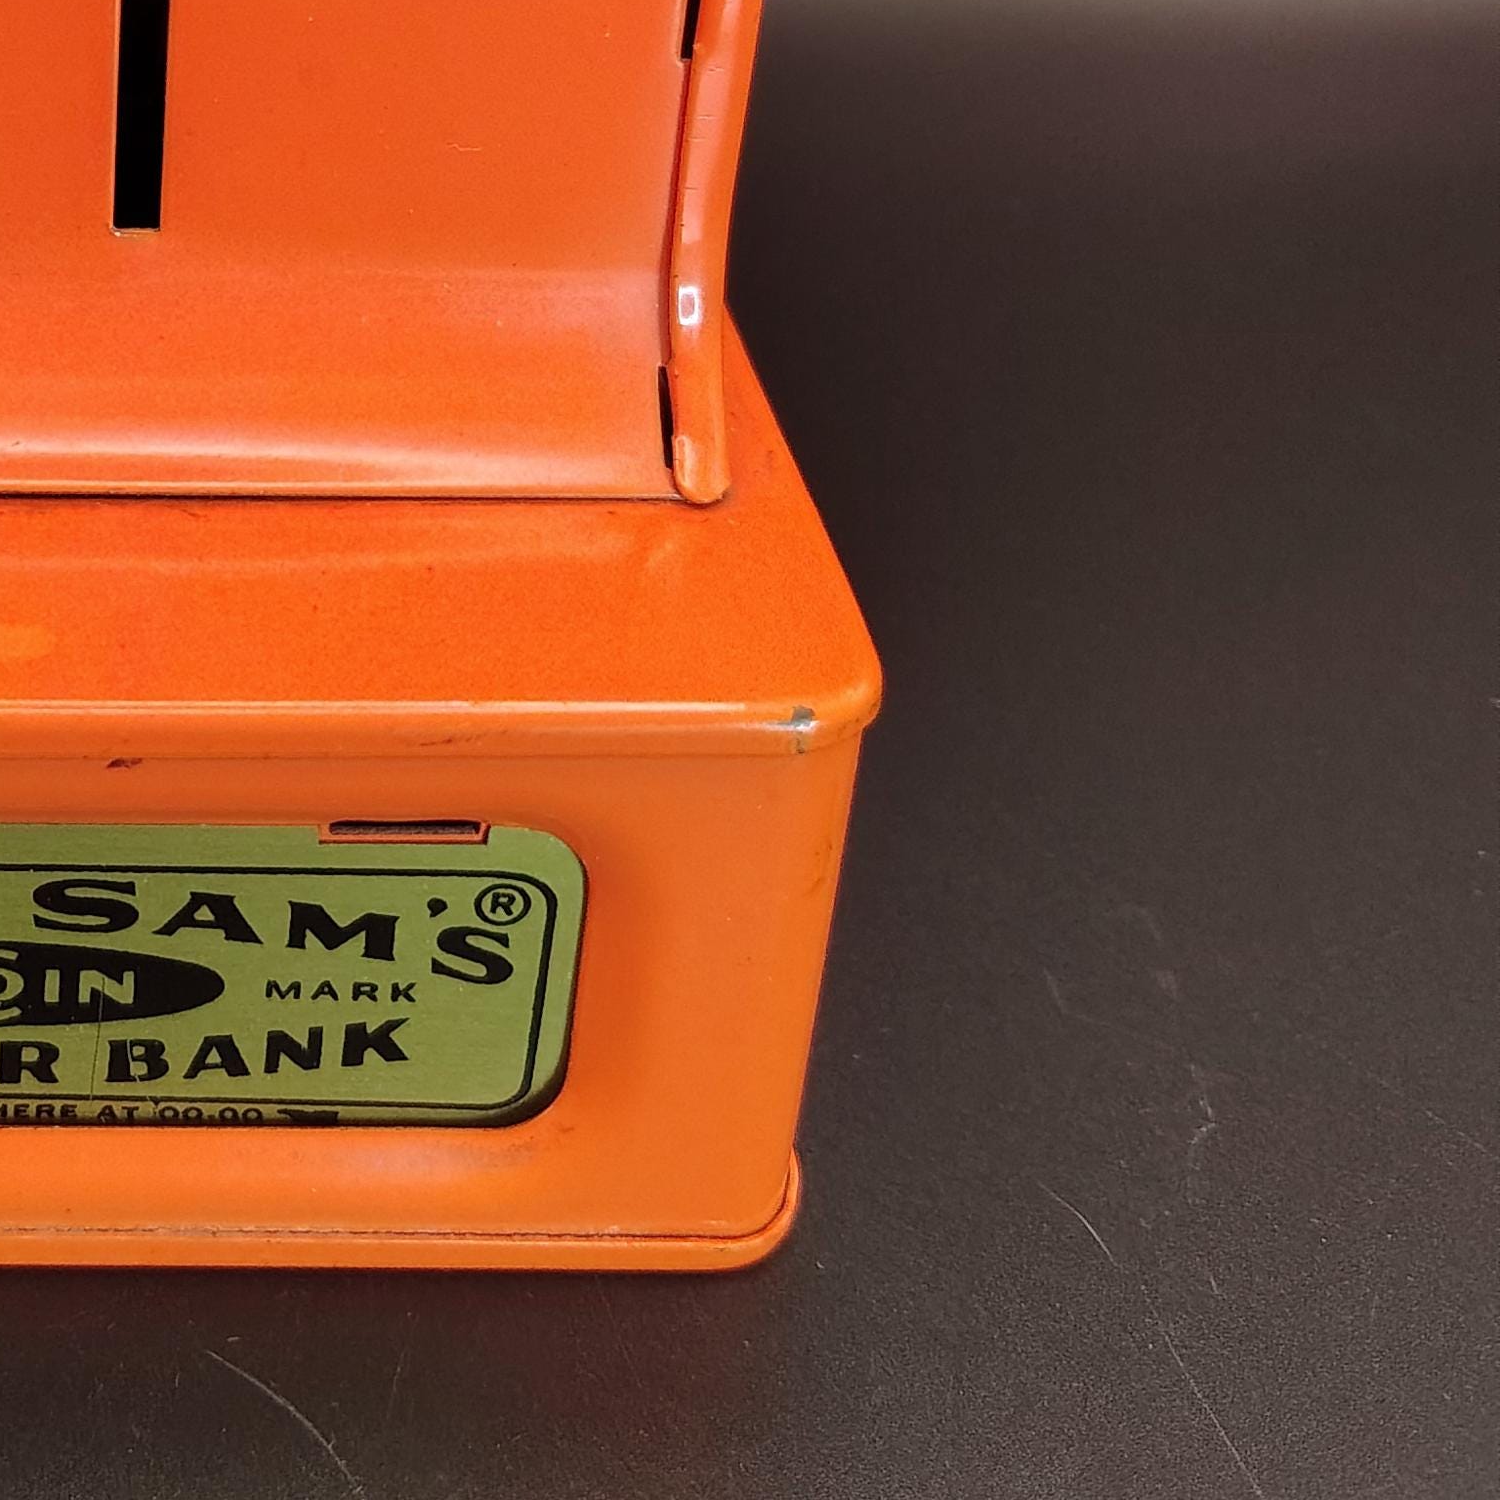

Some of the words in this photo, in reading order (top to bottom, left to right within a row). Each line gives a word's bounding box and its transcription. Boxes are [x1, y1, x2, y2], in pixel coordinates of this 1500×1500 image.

[31, 878, 514, 986] SAM'S
[265, 979, 417, 1002] MARK
[104, 1016, 411, 1083] BANK
[97, 1104, 141, 1123] AT
